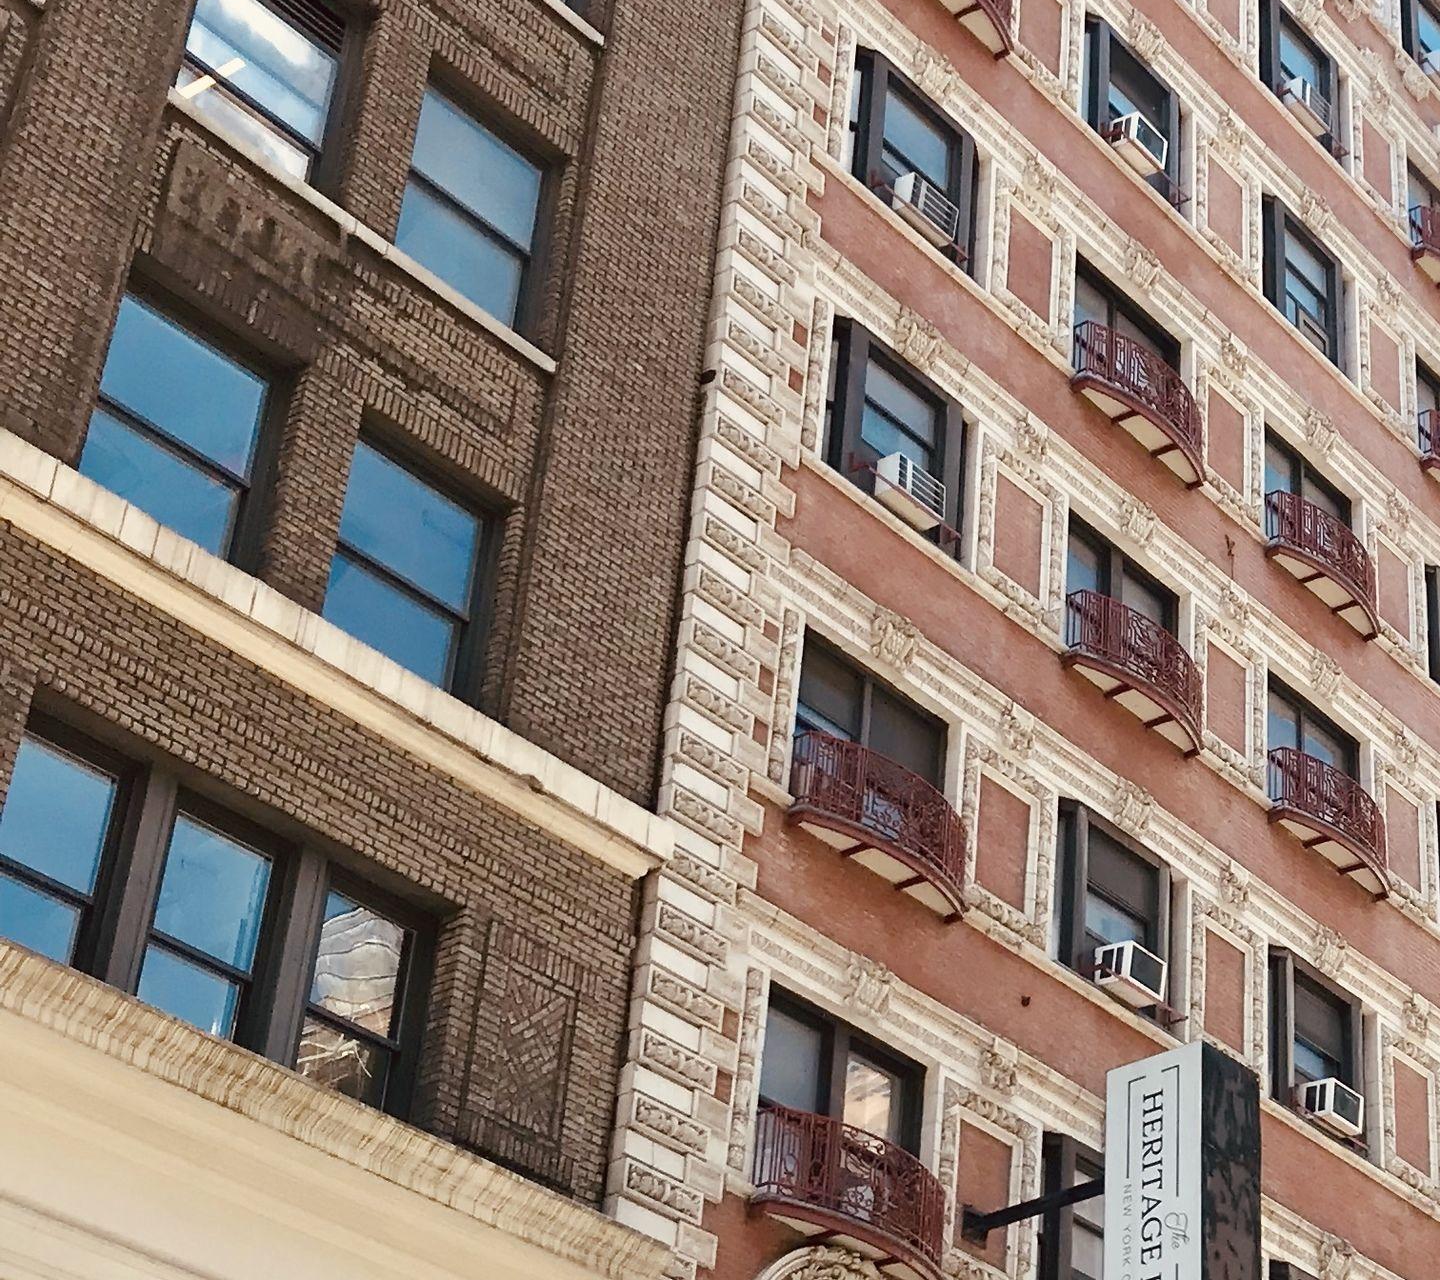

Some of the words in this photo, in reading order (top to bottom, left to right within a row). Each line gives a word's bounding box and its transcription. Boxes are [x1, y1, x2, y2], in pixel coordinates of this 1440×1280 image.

[1141, 1088, 1164, 1265] HERITAGE
[1122, 1183, 1133, 1217] NEW
[1122, 1224, 1133, 1266] YORK
[1164, 1211, 1190, 1251] The
